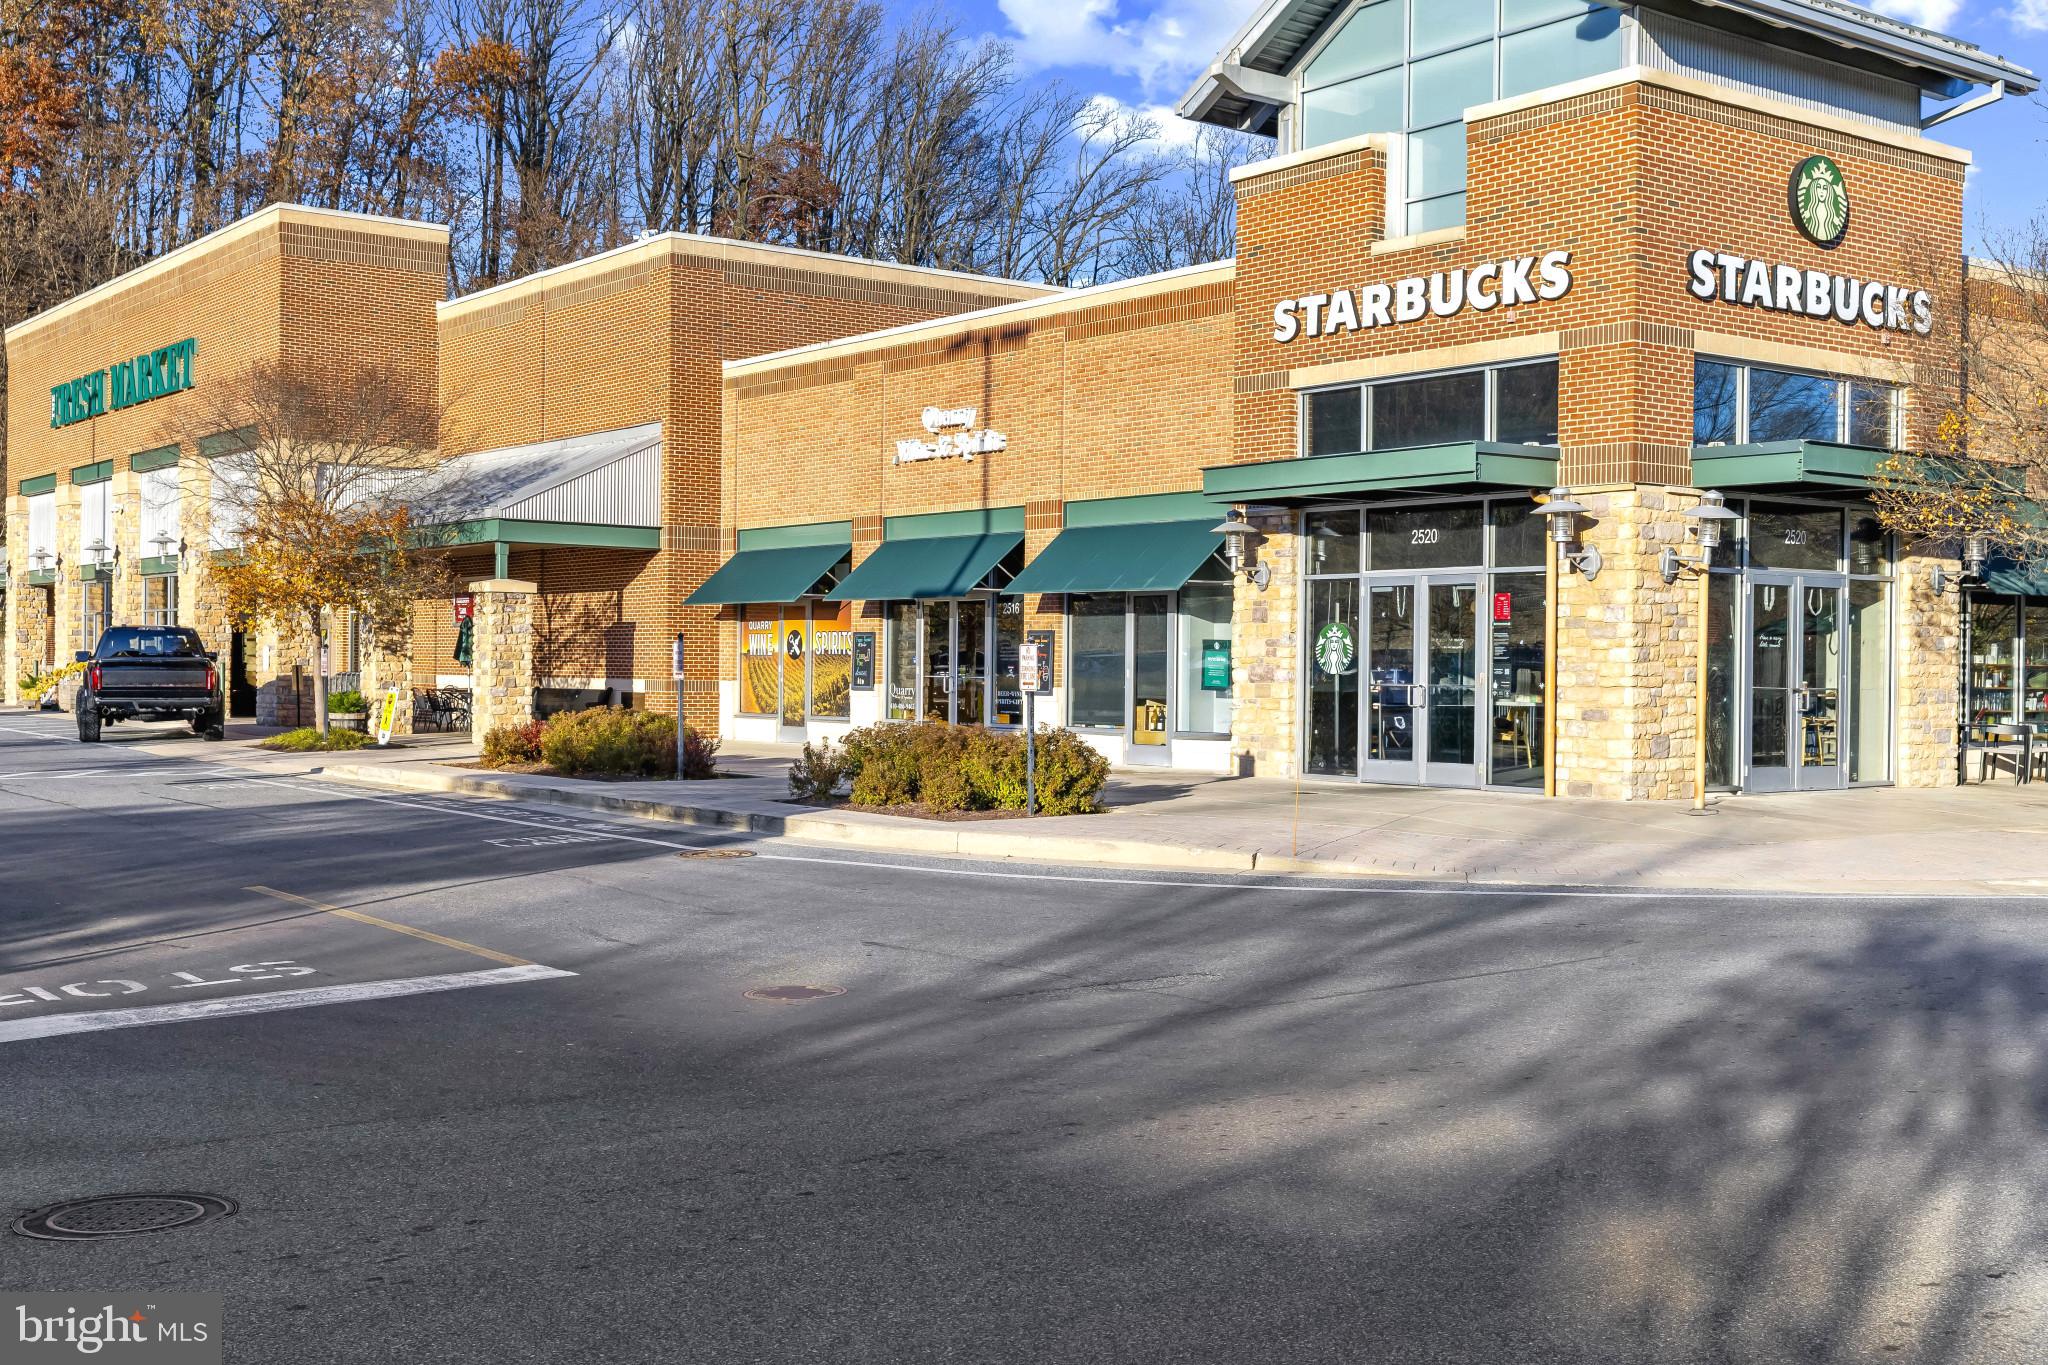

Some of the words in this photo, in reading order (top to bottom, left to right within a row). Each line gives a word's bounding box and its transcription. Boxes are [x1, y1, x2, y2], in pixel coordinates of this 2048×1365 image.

[1273, 250, 1574, 343] STARBUCKS
[1688, 249, 1932, 336] STARBUCKS
[50, 369, 108, 429] FRESH
[110, 337, 199, 411] MARKET
[1411, 529, 1439, 544] 2520
[1784, 529, 1806, 544] 2520
[1003, 602, 1019, 614] 2516
[748, 620, 773, 631] QUARRY
[749, 633, 774, 656] WINE
[815, 631, 852, 655] SPIRITS
[889, 682, 916, 698] Quarry
[0, 960, 318, 1007] STOP
